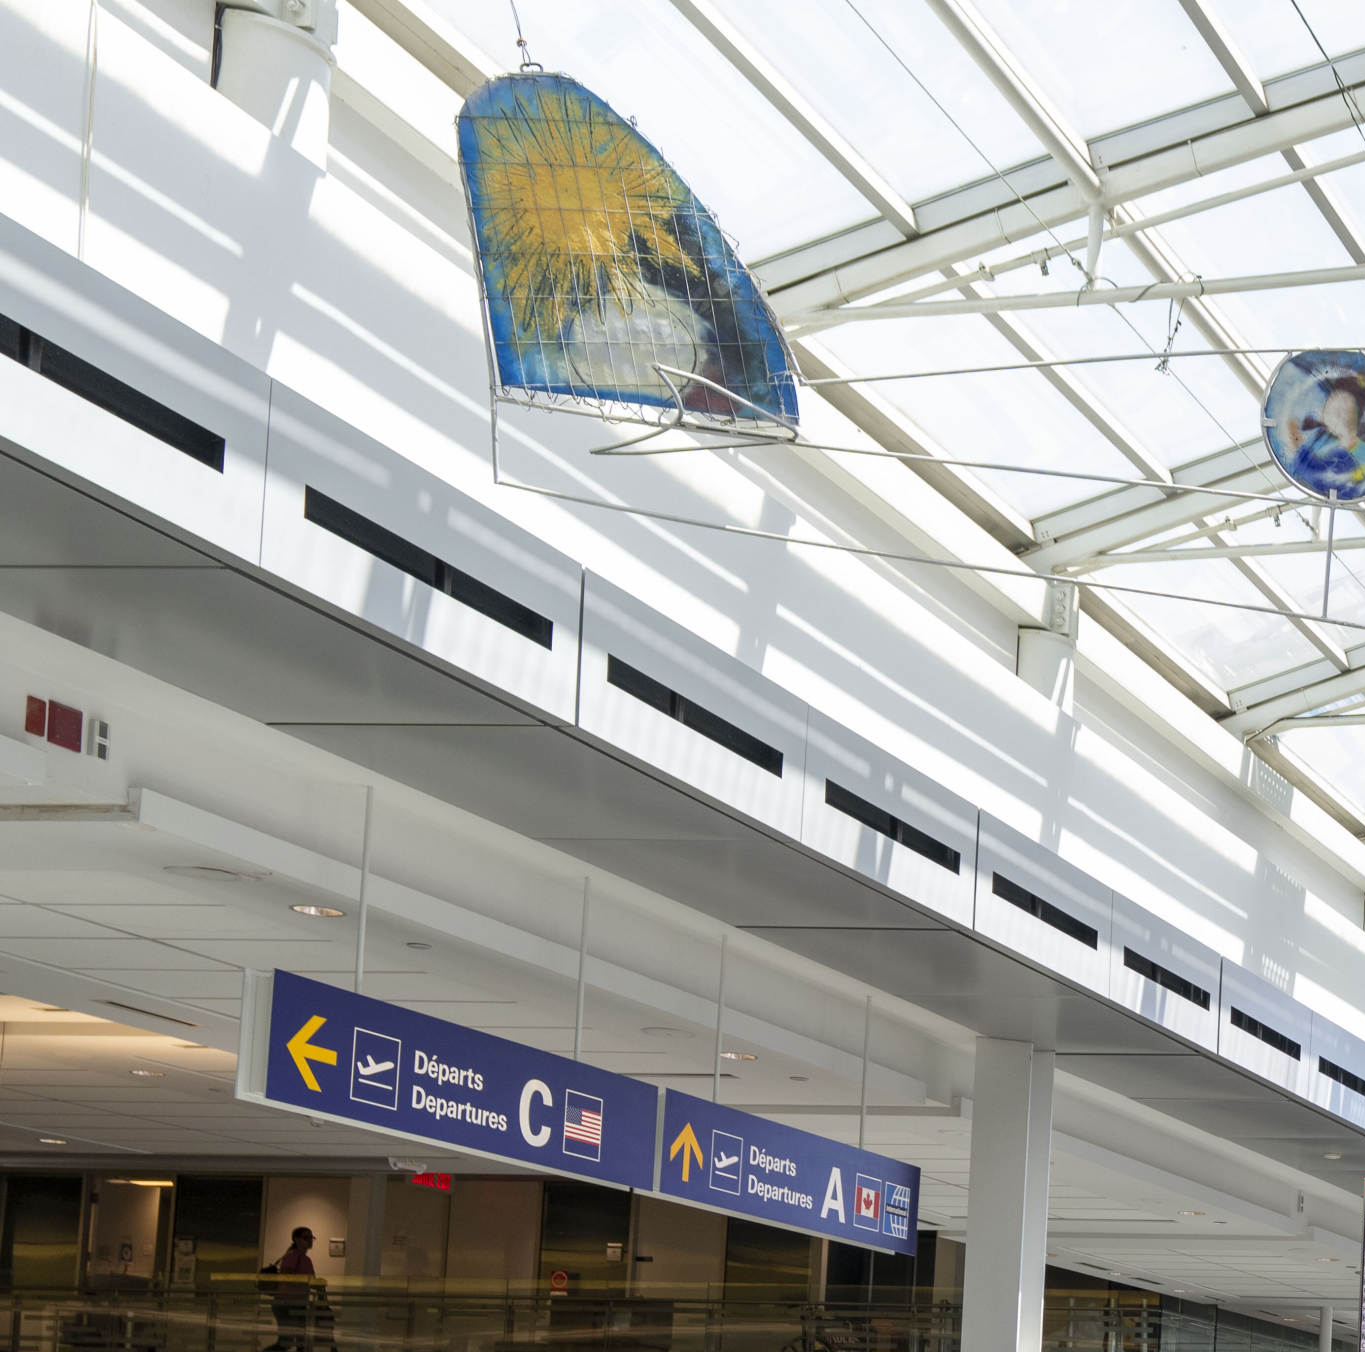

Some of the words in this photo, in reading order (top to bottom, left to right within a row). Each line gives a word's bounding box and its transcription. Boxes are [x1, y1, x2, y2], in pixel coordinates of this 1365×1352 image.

[414, 1050, 484, 1091] Départs
[411, 1085, 507, 1132] Departures
[519, 1078, 553, 1148] C
[750, 1145, 797, 1177] Départs
[747, 1174, 813, 1210] Departures
[820, 1166, 846, 1224] A
